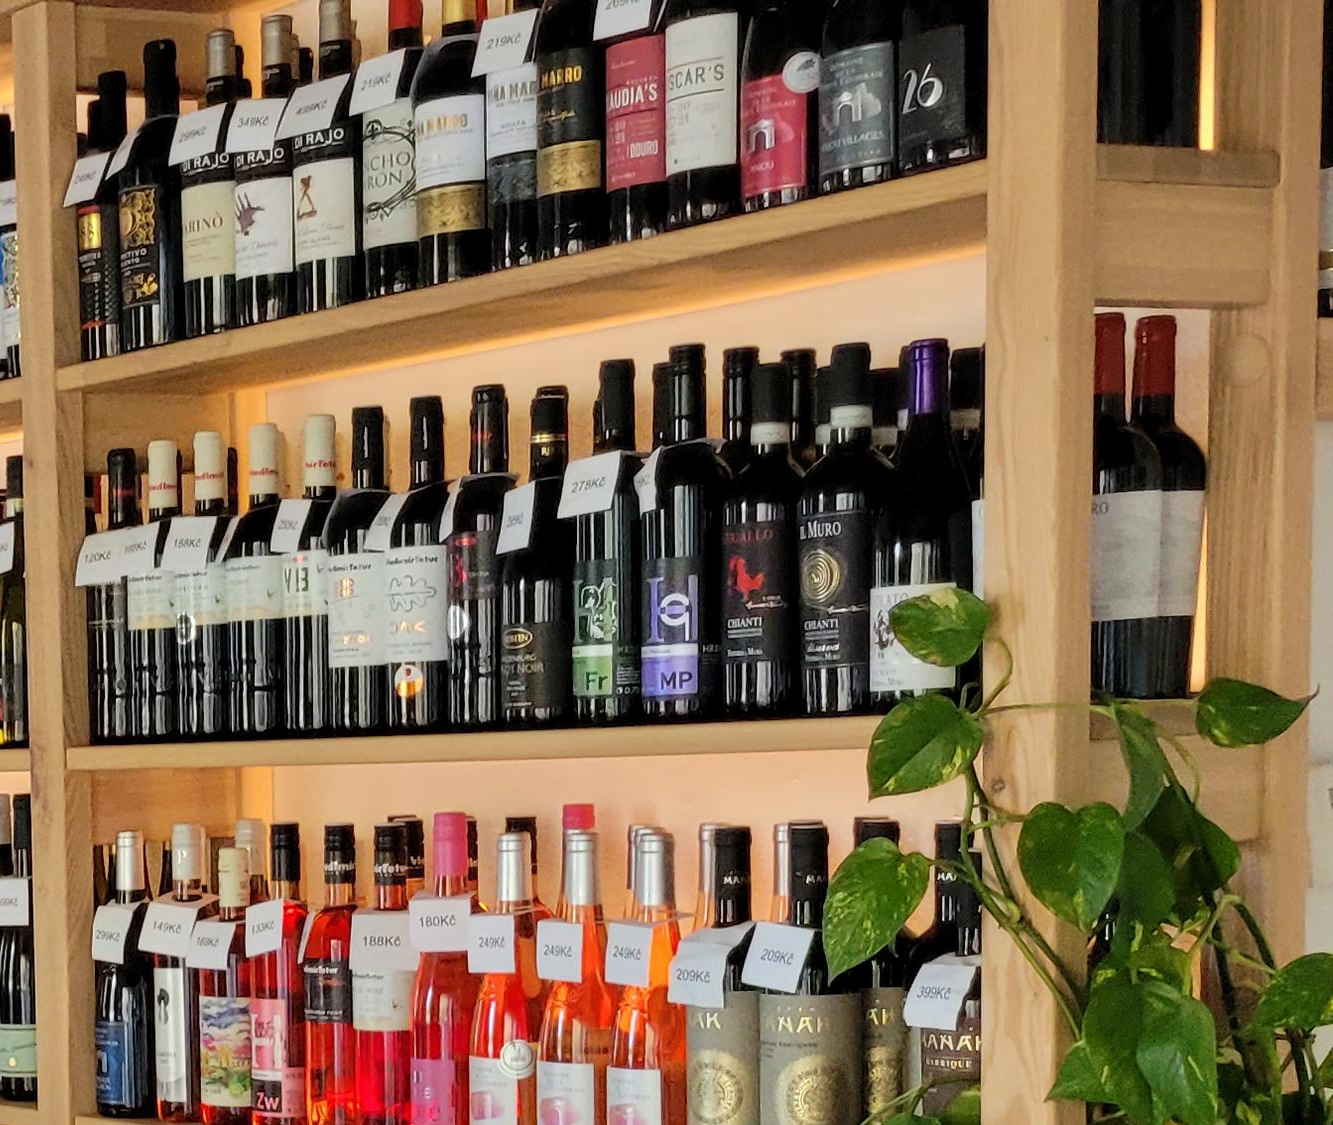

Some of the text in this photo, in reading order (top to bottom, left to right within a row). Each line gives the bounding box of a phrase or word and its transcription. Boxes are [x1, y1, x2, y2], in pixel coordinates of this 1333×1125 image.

[668, 64, 725, 91] SCAR'S
[901, 63, 944, 115] 26
[608, 83, 658, 113] AUDIA'S
[807, 521, 842, 539] MURO
[727, 616, 763, 628] CHIANTI
[804, 618, 839, 631] CHIANTI
[585, 672, 608, 691] Fr
[660, 671, 694, 690] MP
[153, 920, 182, 935] 149Kč
[419, 914, 457, 928] 180Kč
[363, 935, 401, 947] 188Kč
[543, 944, 573, 958] 249Kč
[613, 946, 642, 961] 249Kč
[760, 948, 795, 966] 209Kč
[676, 968, 711, 983] 209Kč
[917, 985, 952, 1000] 399Kč
[256, 1091, 281, 1110] Zw
